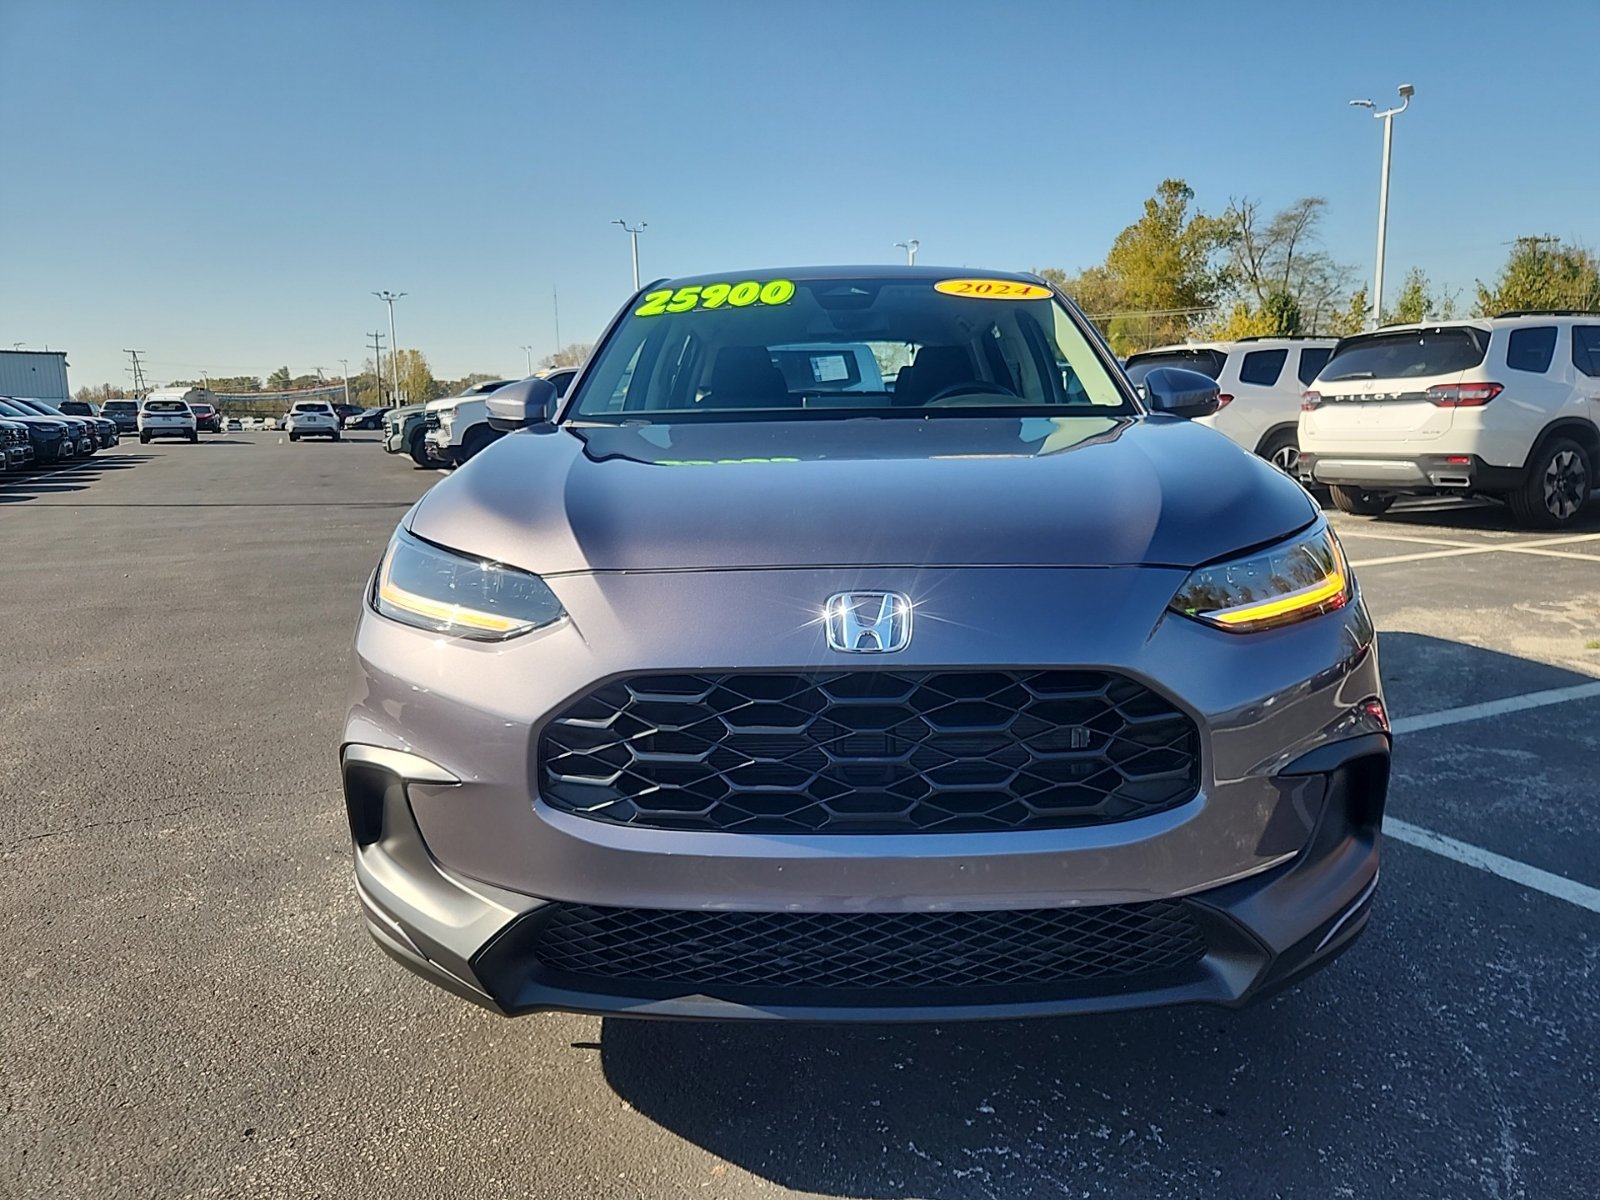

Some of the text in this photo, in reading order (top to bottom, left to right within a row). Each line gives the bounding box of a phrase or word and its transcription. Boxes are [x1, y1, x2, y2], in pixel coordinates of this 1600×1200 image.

[956, 283, 1032, 295] 2024
[634, 279, 795, 316] 25900
[1335, 392, 1402, 402] PILOT
